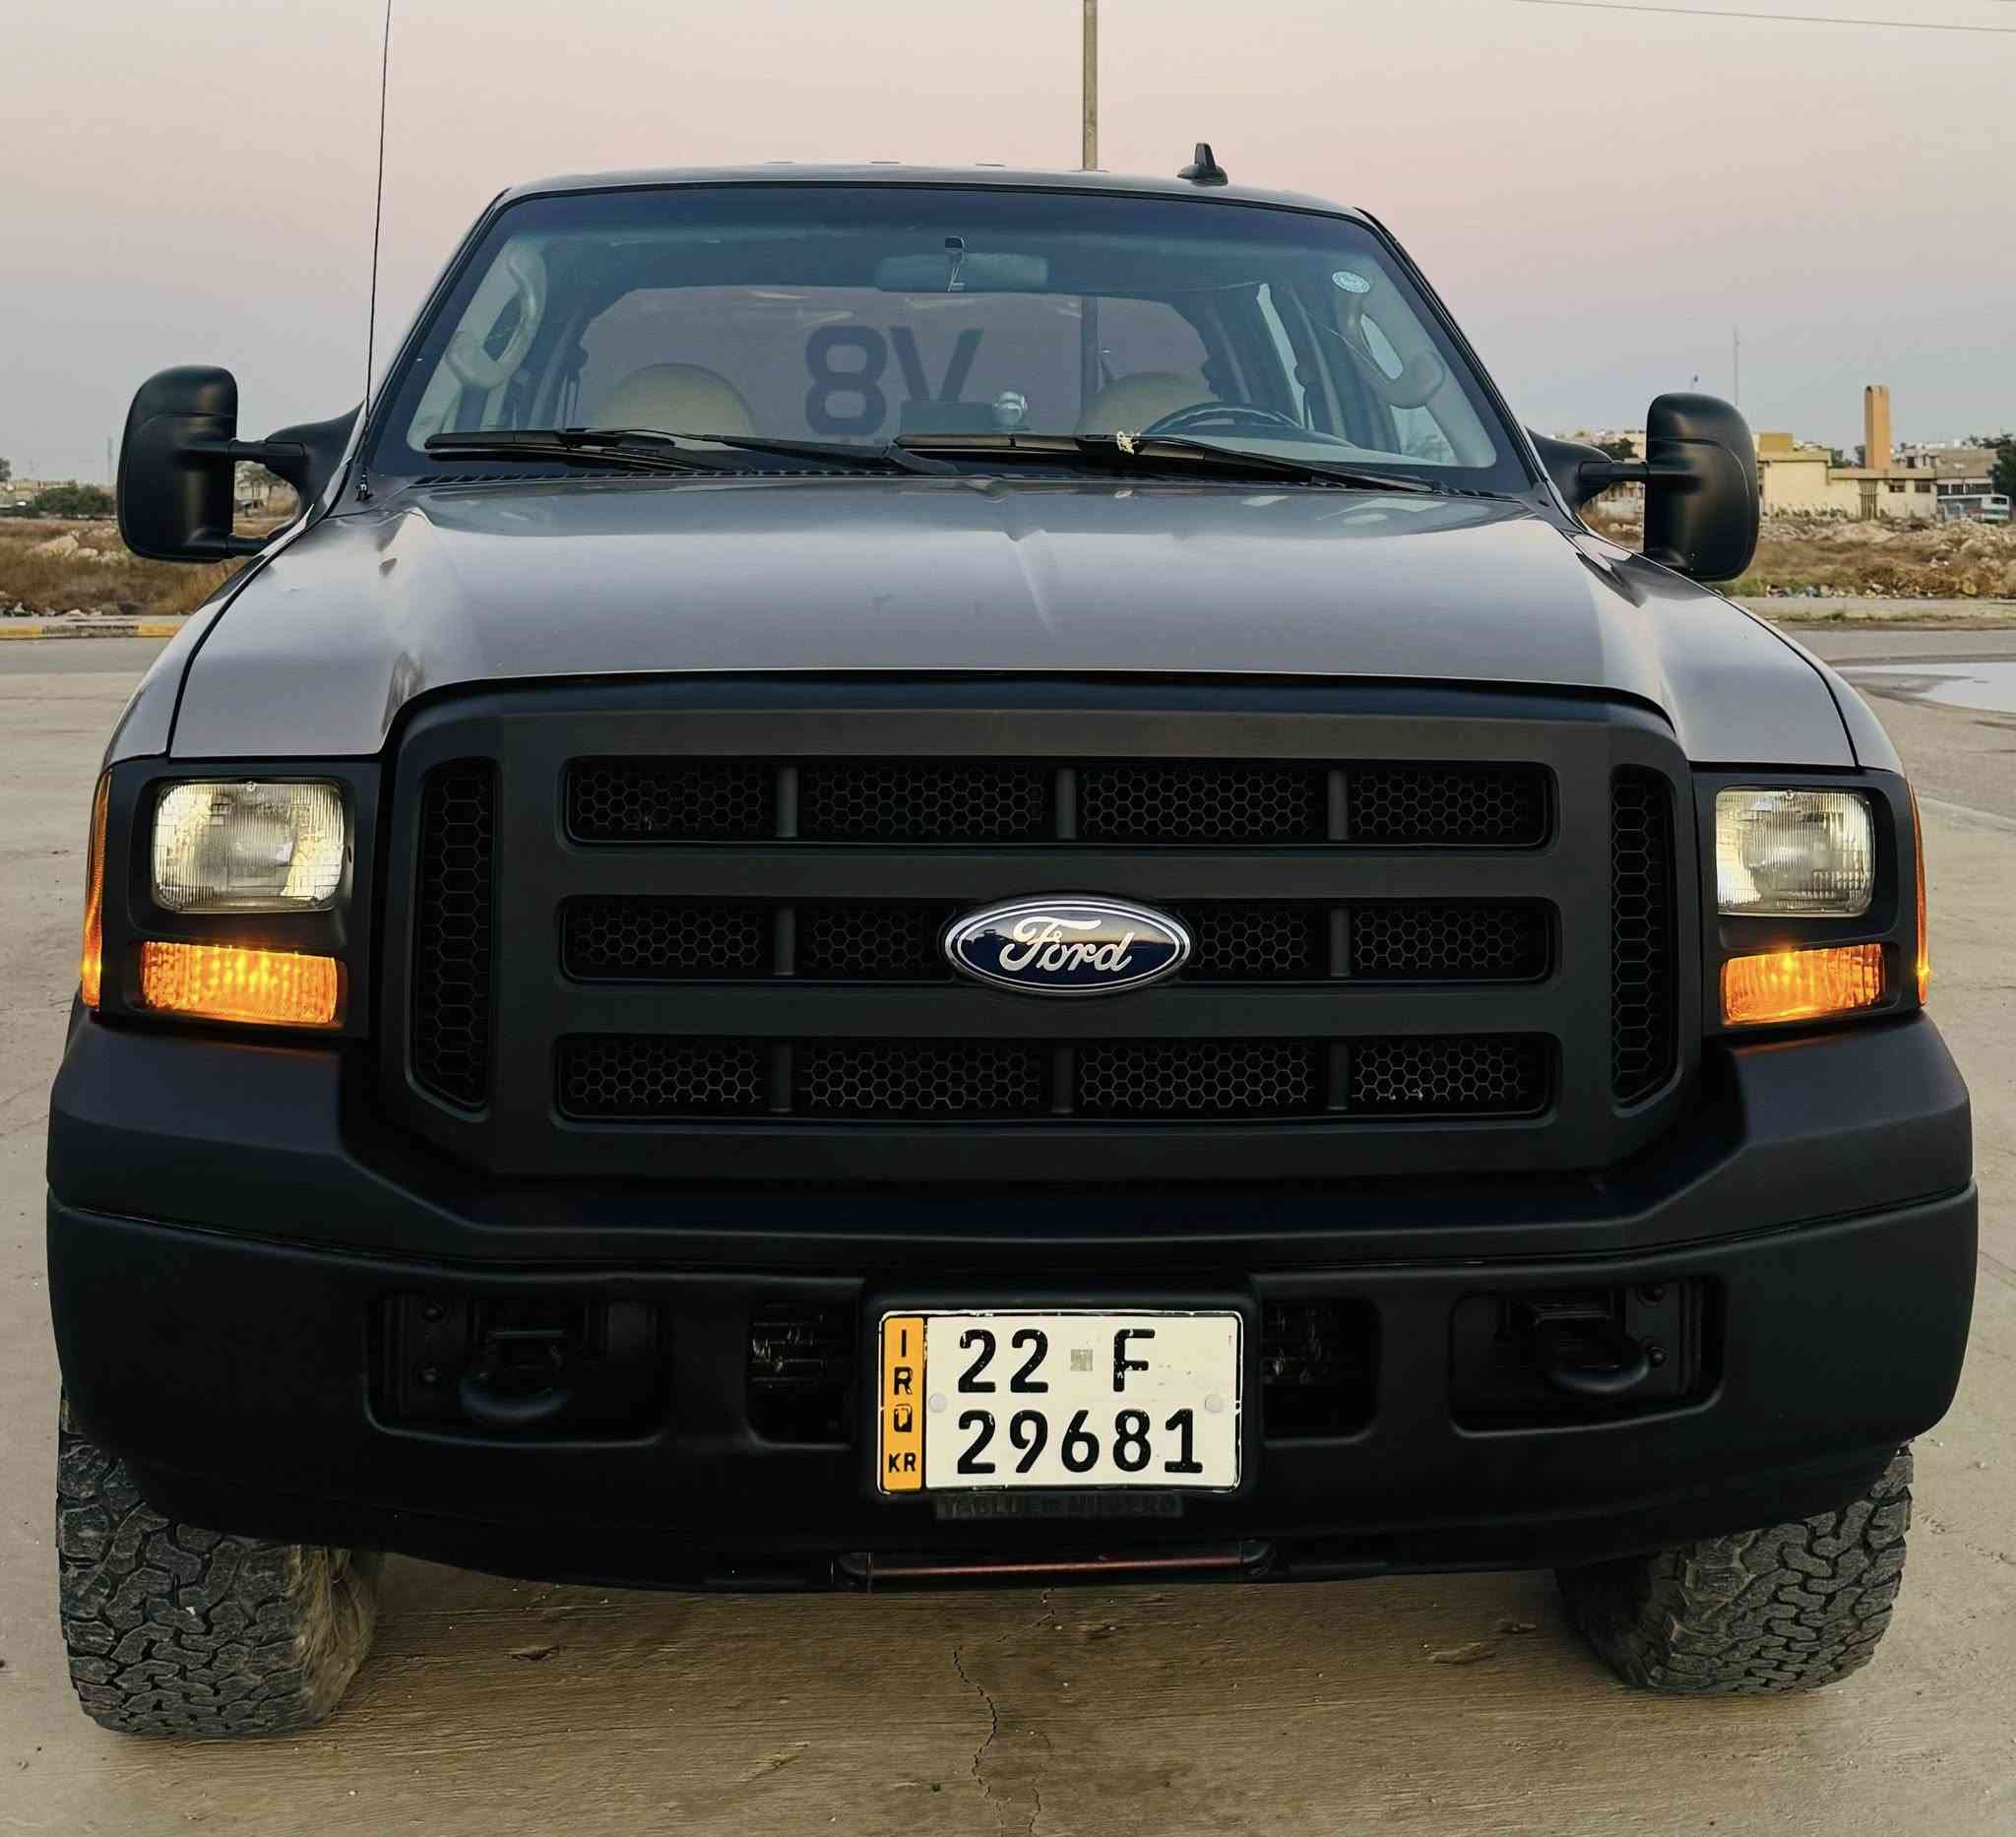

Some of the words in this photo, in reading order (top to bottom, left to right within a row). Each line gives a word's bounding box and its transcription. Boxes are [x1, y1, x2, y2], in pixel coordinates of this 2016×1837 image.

[998, 916, 1135, 972] Ford
[957, 1328, 1049, 1394] 22
[1112, 1328, 1157, 1393] F
[888, 1451, 916, 1474] KR
[956, 1408, 1204, 1475] 29681
